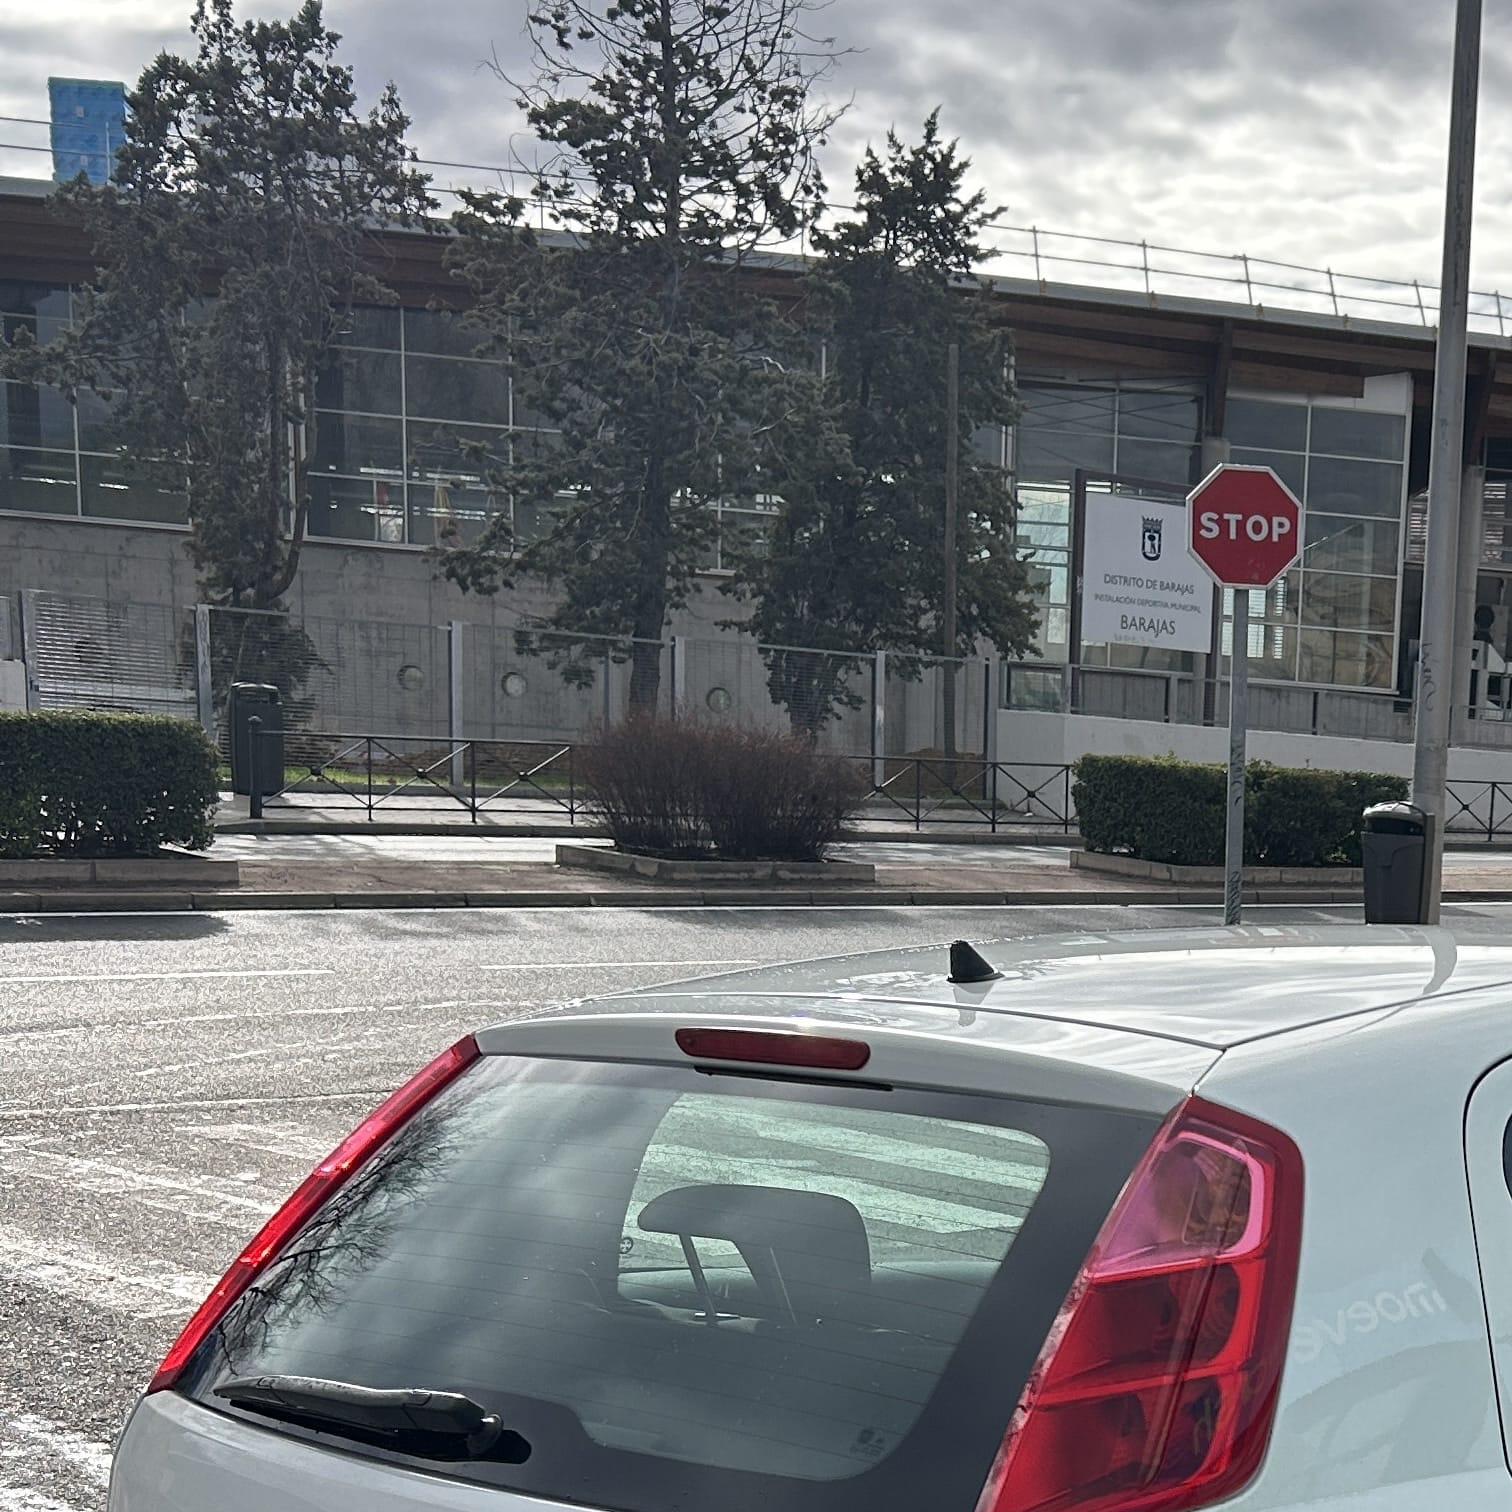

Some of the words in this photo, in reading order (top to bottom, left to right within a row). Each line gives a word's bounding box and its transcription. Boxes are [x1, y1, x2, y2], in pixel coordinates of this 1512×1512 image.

[1199, 511, 1292, 543] STOP
[1103, 573, 1145, 588] DISTRITO
[1145, 579, 1158, 590] DE
[1159, 580, 1195, 596] BARAJAS
[1120, 614, 1176, 639] BARAJAS
